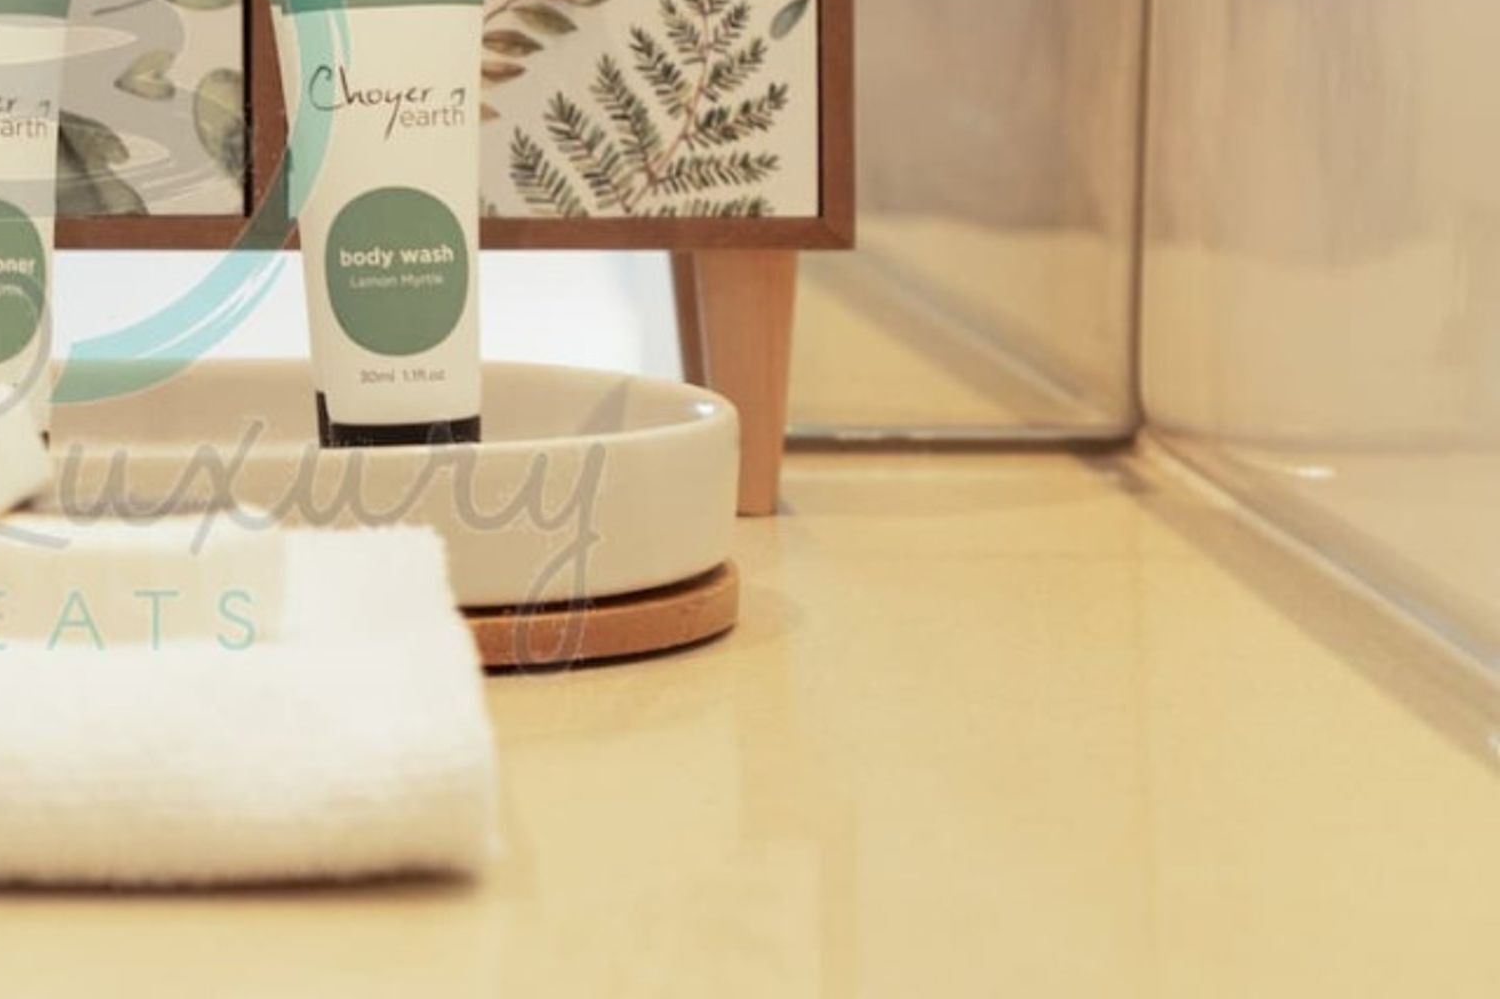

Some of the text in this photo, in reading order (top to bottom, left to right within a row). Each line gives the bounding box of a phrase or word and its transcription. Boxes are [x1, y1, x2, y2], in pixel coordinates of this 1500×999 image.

[399, 101, 466, 128] earth
[339, 244, 455, 270] body wash
